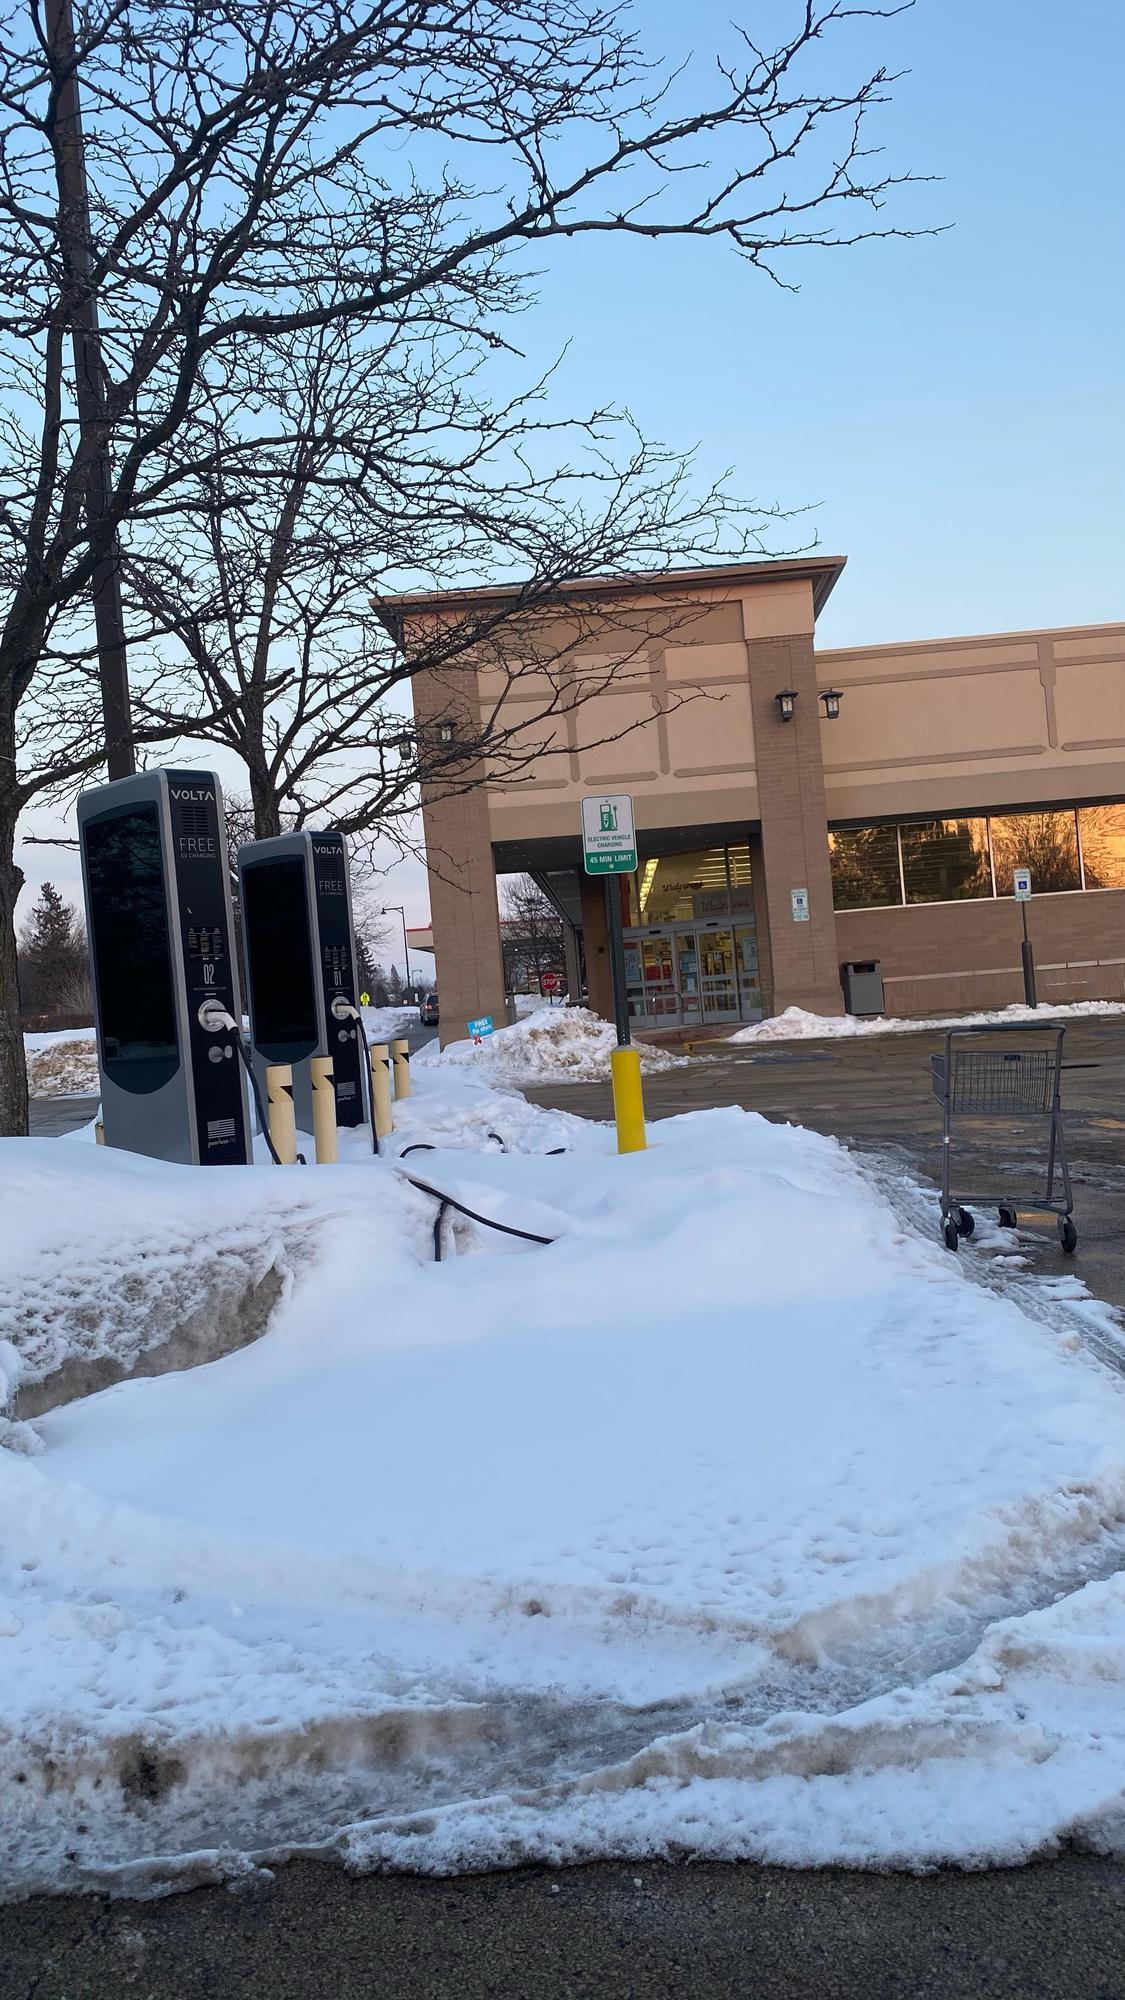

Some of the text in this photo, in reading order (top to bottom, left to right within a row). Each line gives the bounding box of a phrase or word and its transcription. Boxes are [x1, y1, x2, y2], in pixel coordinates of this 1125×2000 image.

[170, 789, 214, 800] VOLTA
[180, 838, 216, 852] FREE
[320, 880, 343, 890] FREE
[204, 964, 215, 984] 02
[334, 970, 342, 986] 01
